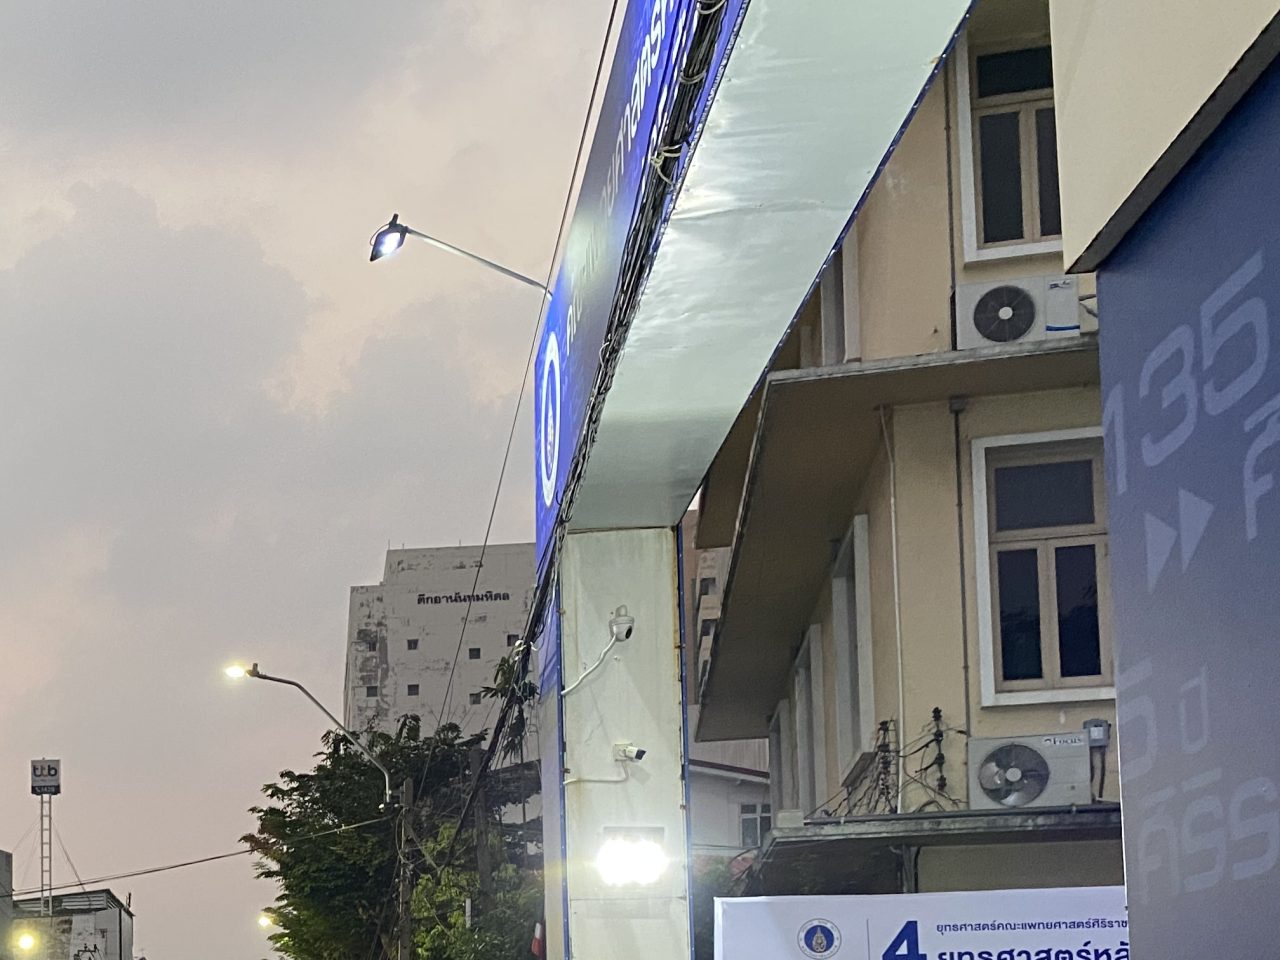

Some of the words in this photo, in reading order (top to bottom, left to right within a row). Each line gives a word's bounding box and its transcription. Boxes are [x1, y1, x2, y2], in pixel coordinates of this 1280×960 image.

[1100, 249, 1269, 497] 135
[417, 591, 510, 605] ตึกอานันทมหิดล
[33, 764, 58, 778] ttb
